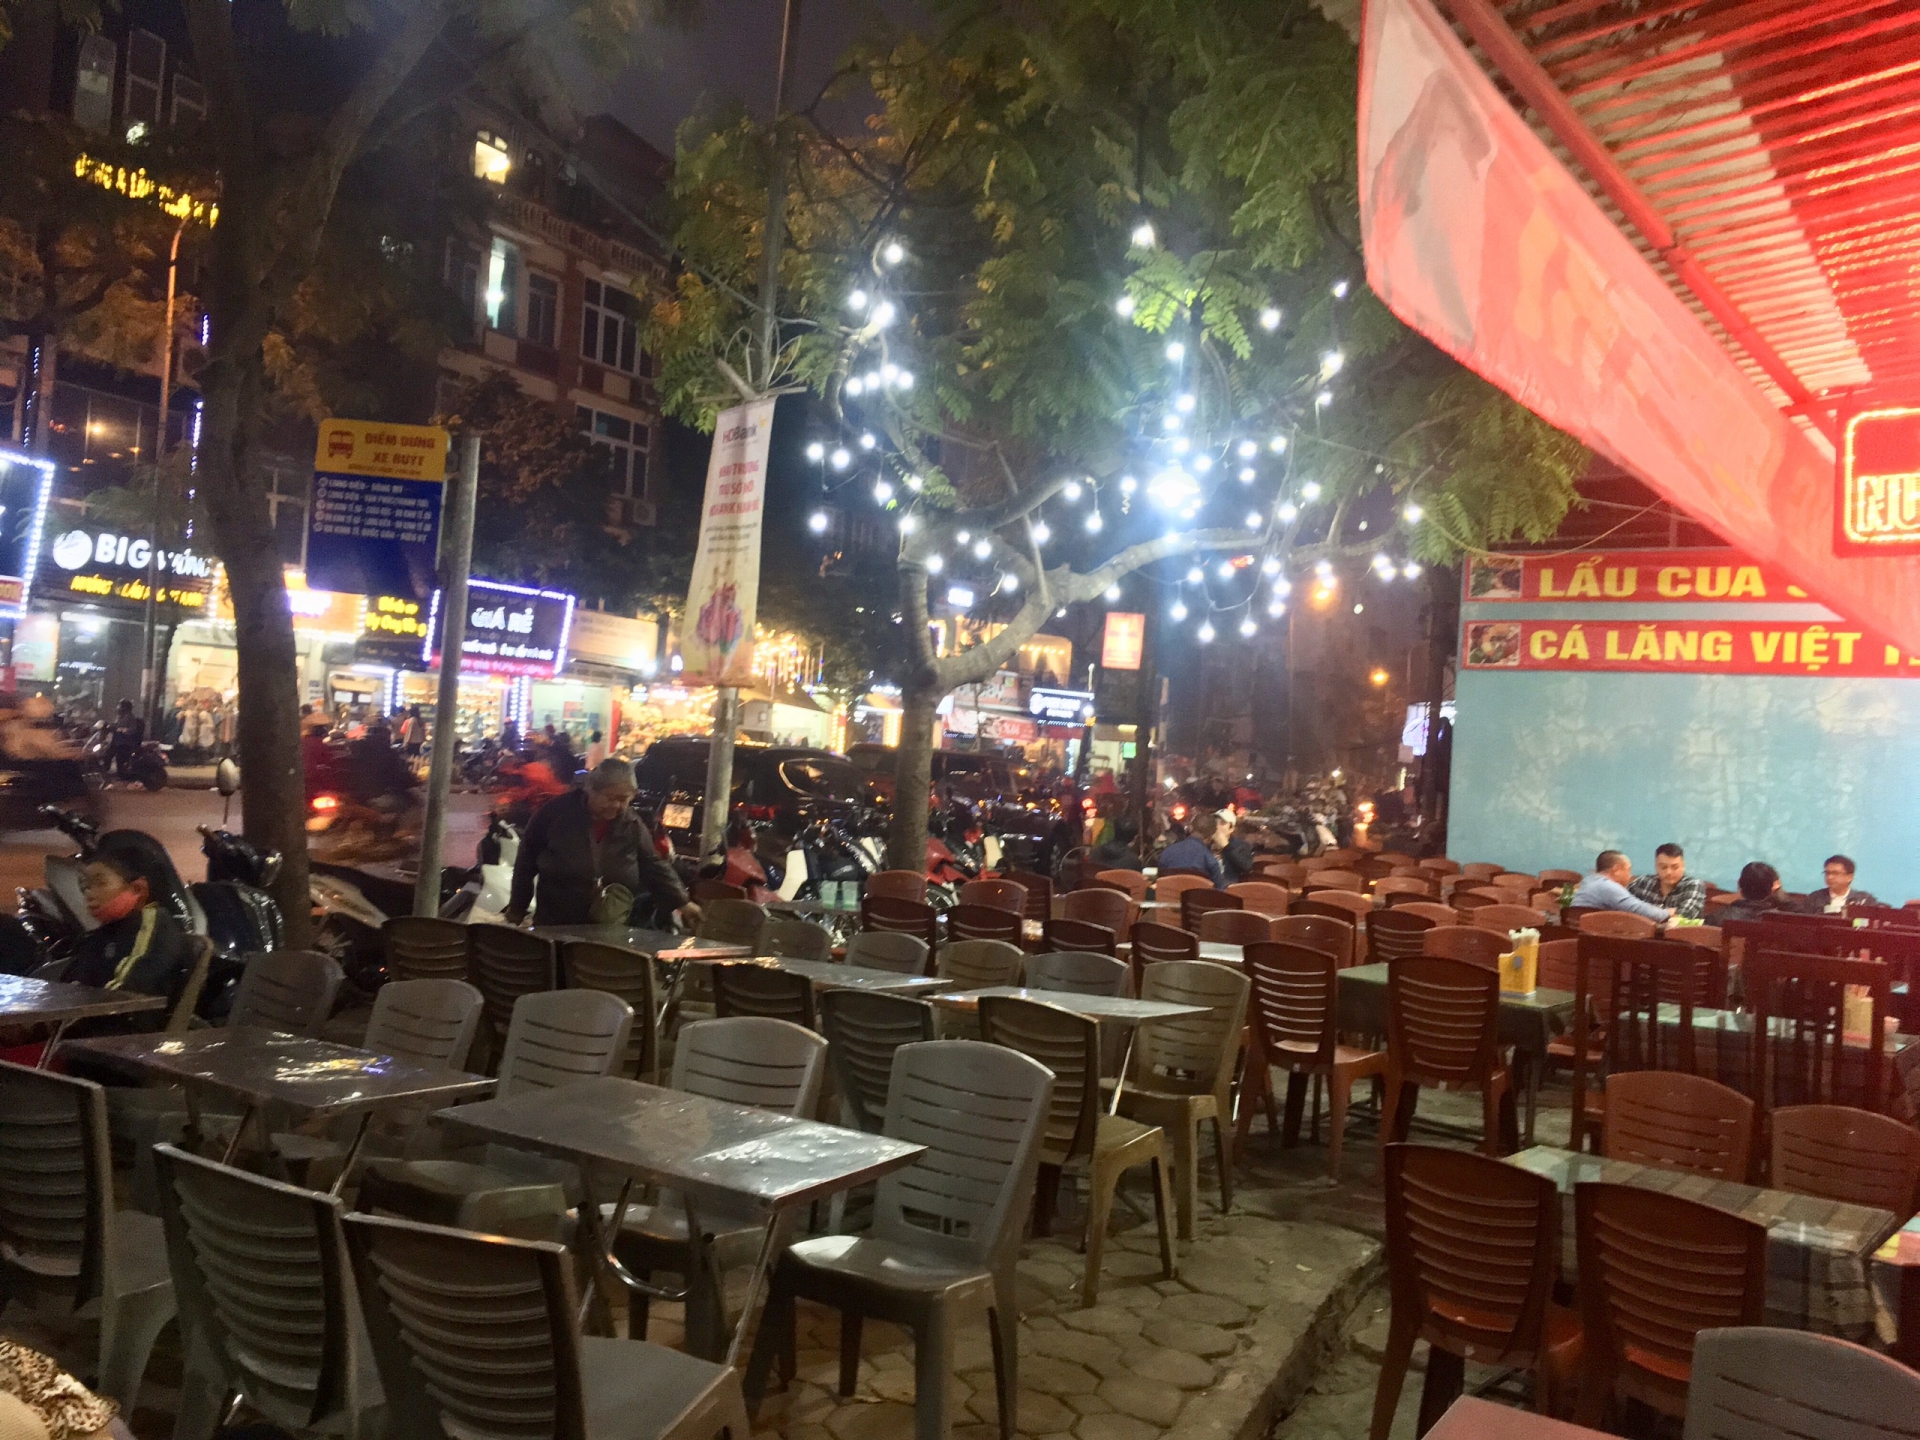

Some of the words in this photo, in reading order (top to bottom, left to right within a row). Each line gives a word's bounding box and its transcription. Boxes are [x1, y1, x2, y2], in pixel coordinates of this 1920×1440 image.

[94, 533, 152, 569] BIG
[1539, 556, 1638, 598] LẨU
[1657, 566, 1767, 597] CUA
[1529, 624, 1590, 660] CÁ
[1605, 624, 1732, 662] LĂNG
[1750, 625, 1862, 671] VIỆT
